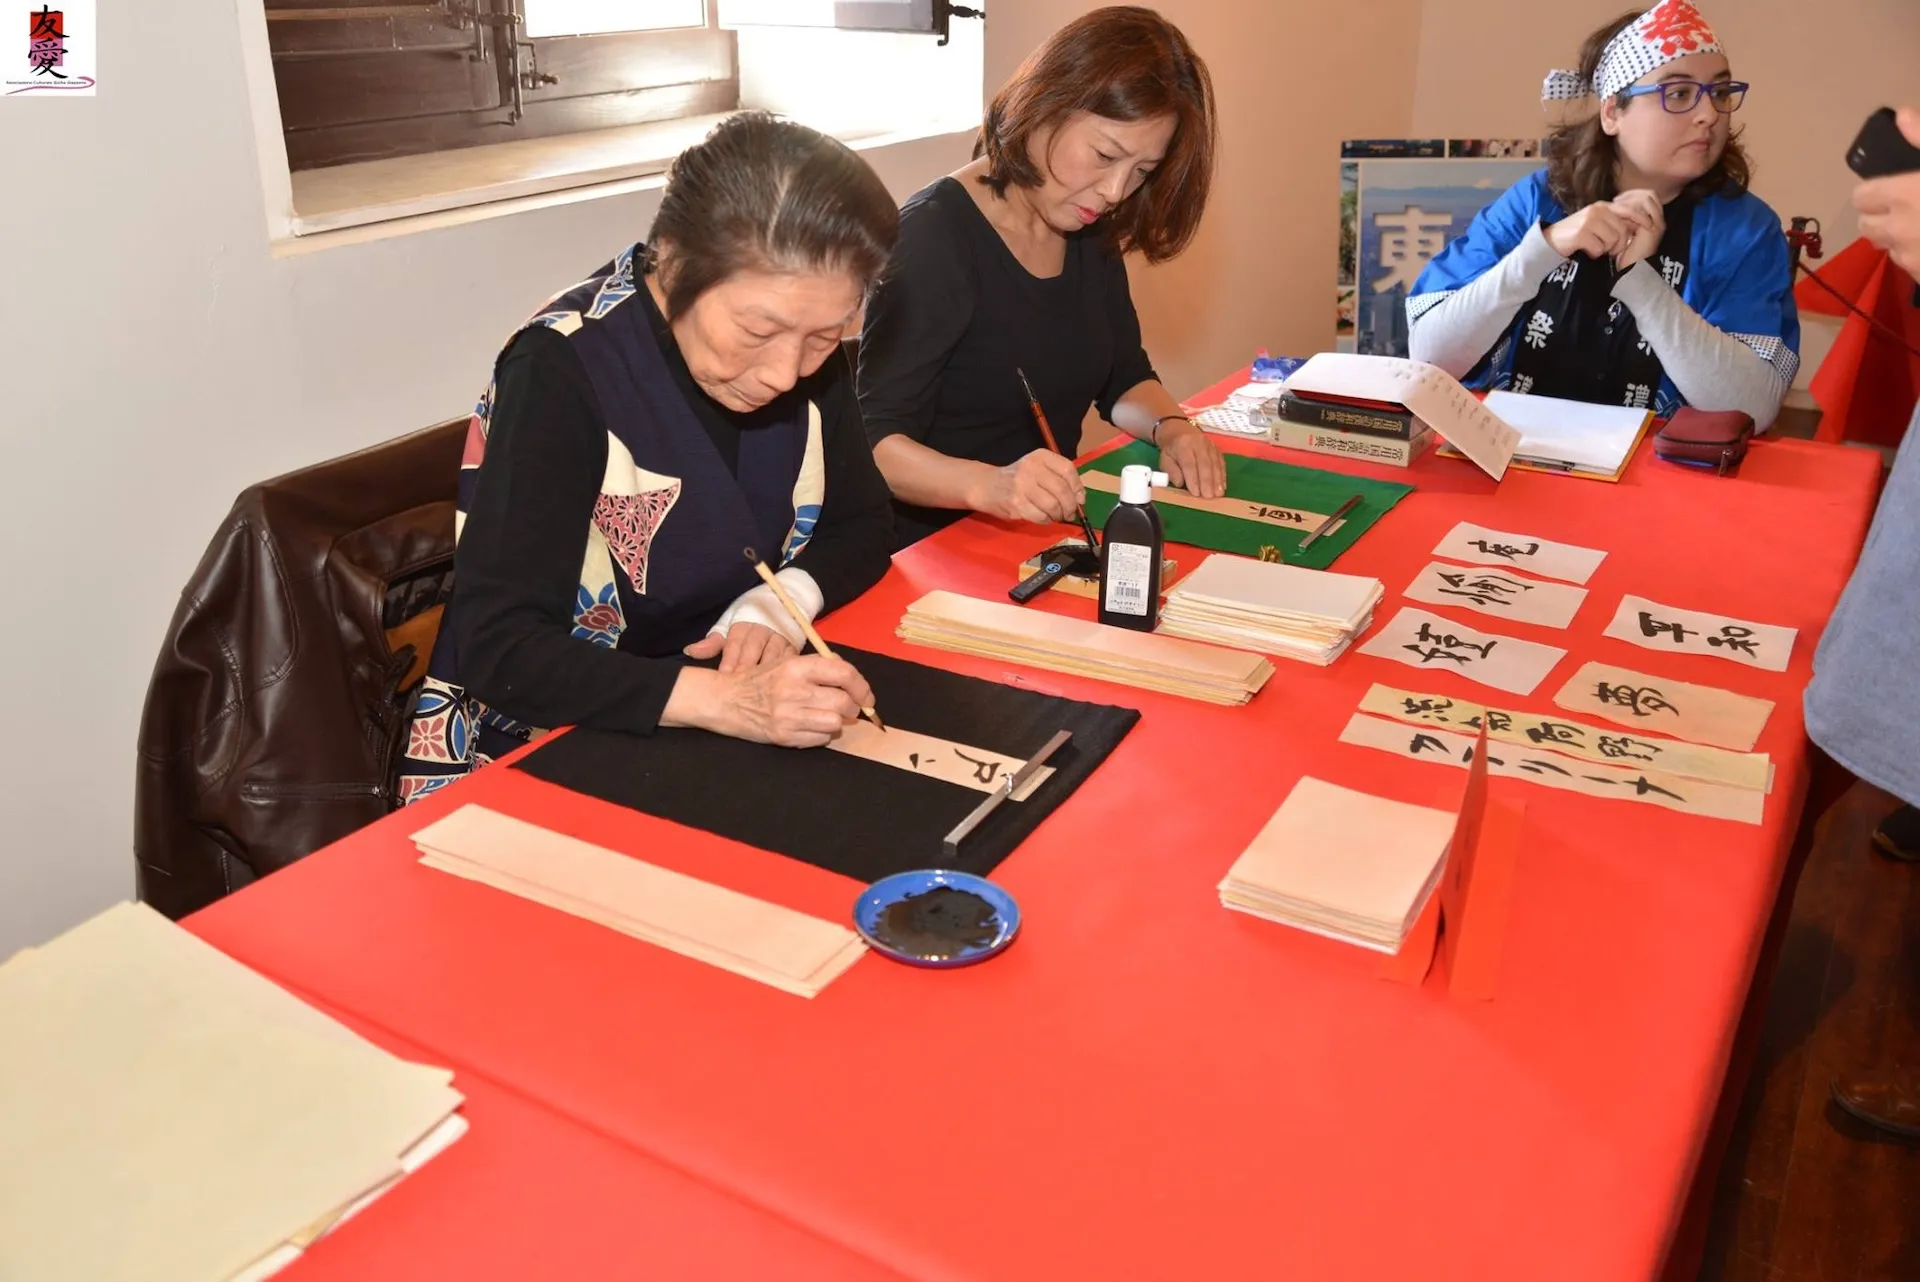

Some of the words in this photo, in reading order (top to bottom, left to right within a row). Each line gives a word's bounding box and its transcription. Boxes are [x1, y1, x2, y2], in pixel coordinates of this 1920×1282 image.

[1372, 205, 1452, 293] 東
[1637, 611, 1761, 660] 平和
[1592, 681, 1680, 717] 夢
